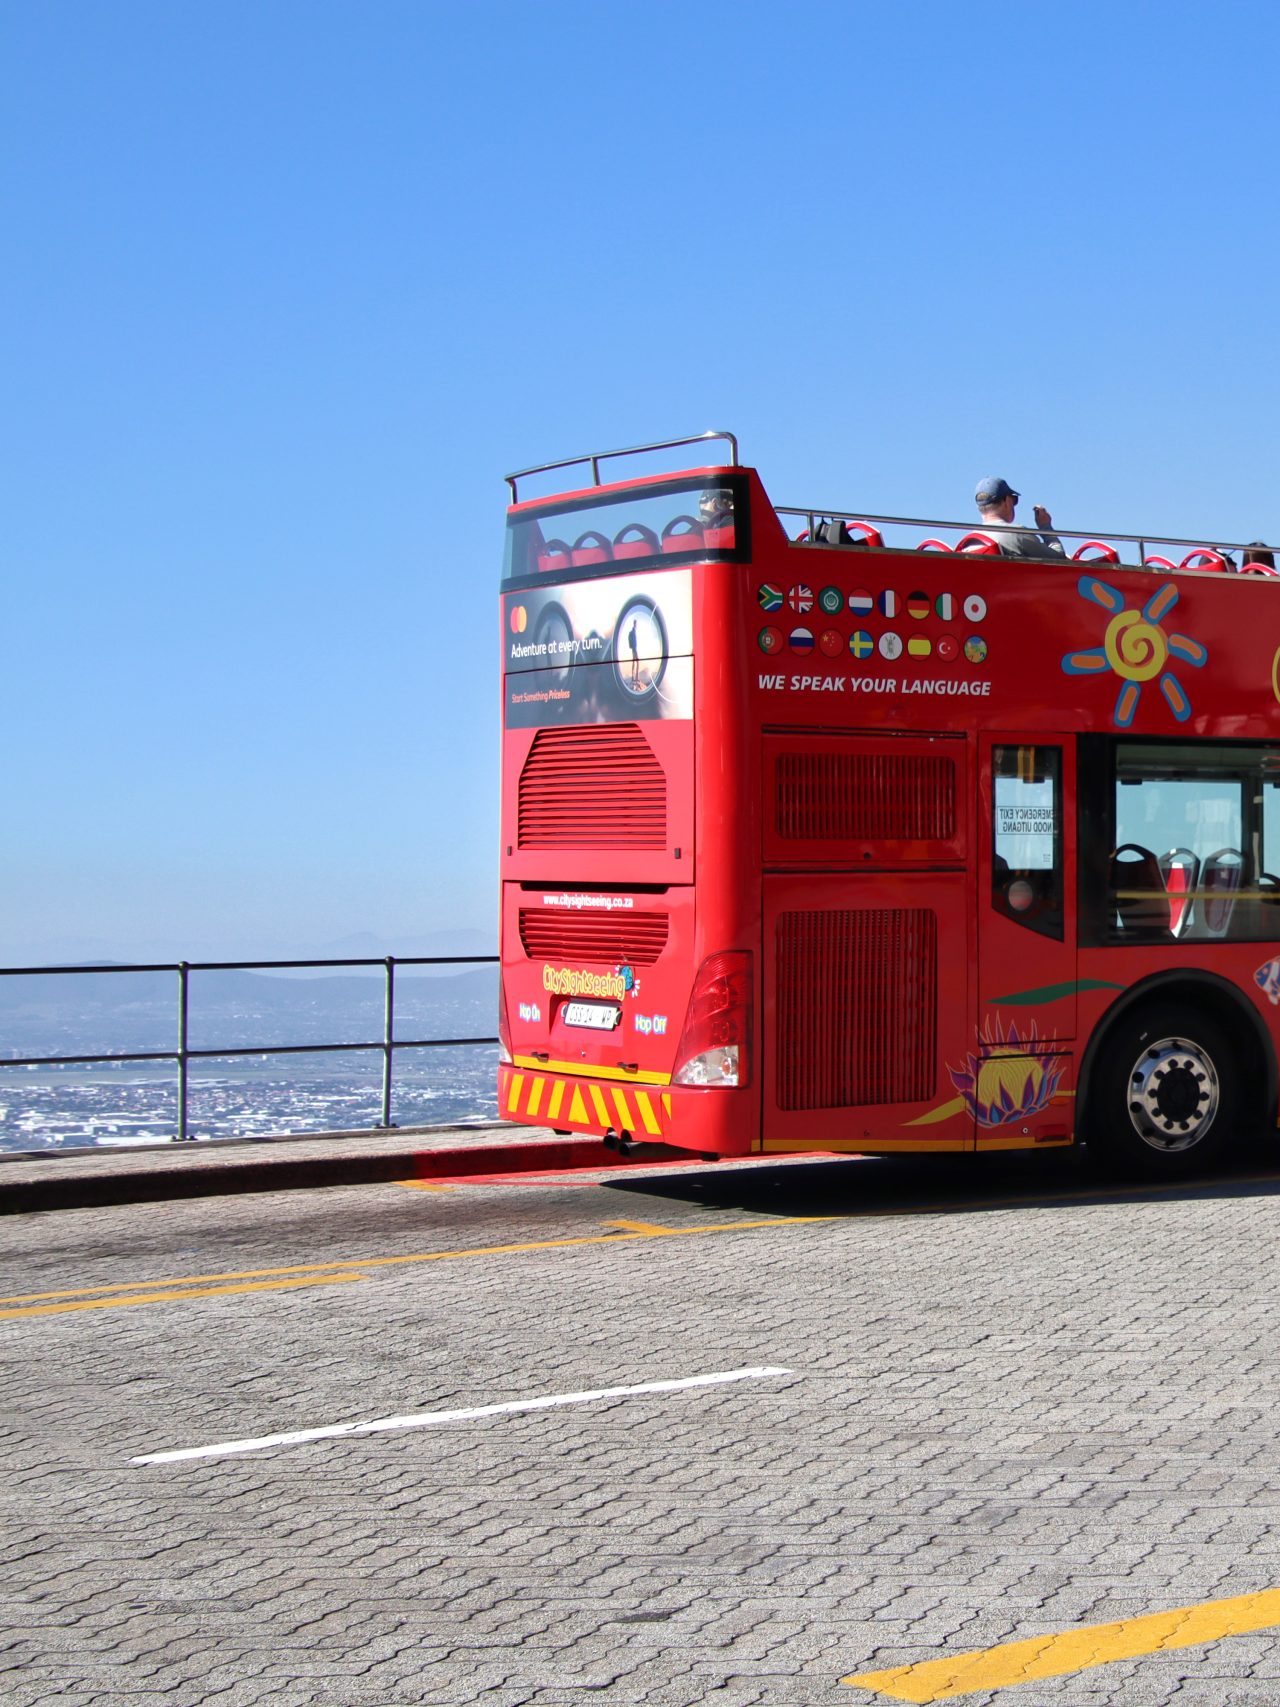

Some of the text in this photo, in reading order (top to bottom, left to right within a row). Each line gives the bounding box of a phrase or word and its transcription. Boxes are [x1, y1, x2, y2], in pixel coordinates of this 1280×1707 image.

[511, 637, 603, 659] Adventure at every turn.
[758, 674, 991, 696] WE SPEAK YOUR LANGUAGE
[543, 892, 634, 911] www.citysightseeing.co.za
[519, 1003, 541, 1023] Hop On
[634, 1013, 668, 1035] Hop Off
